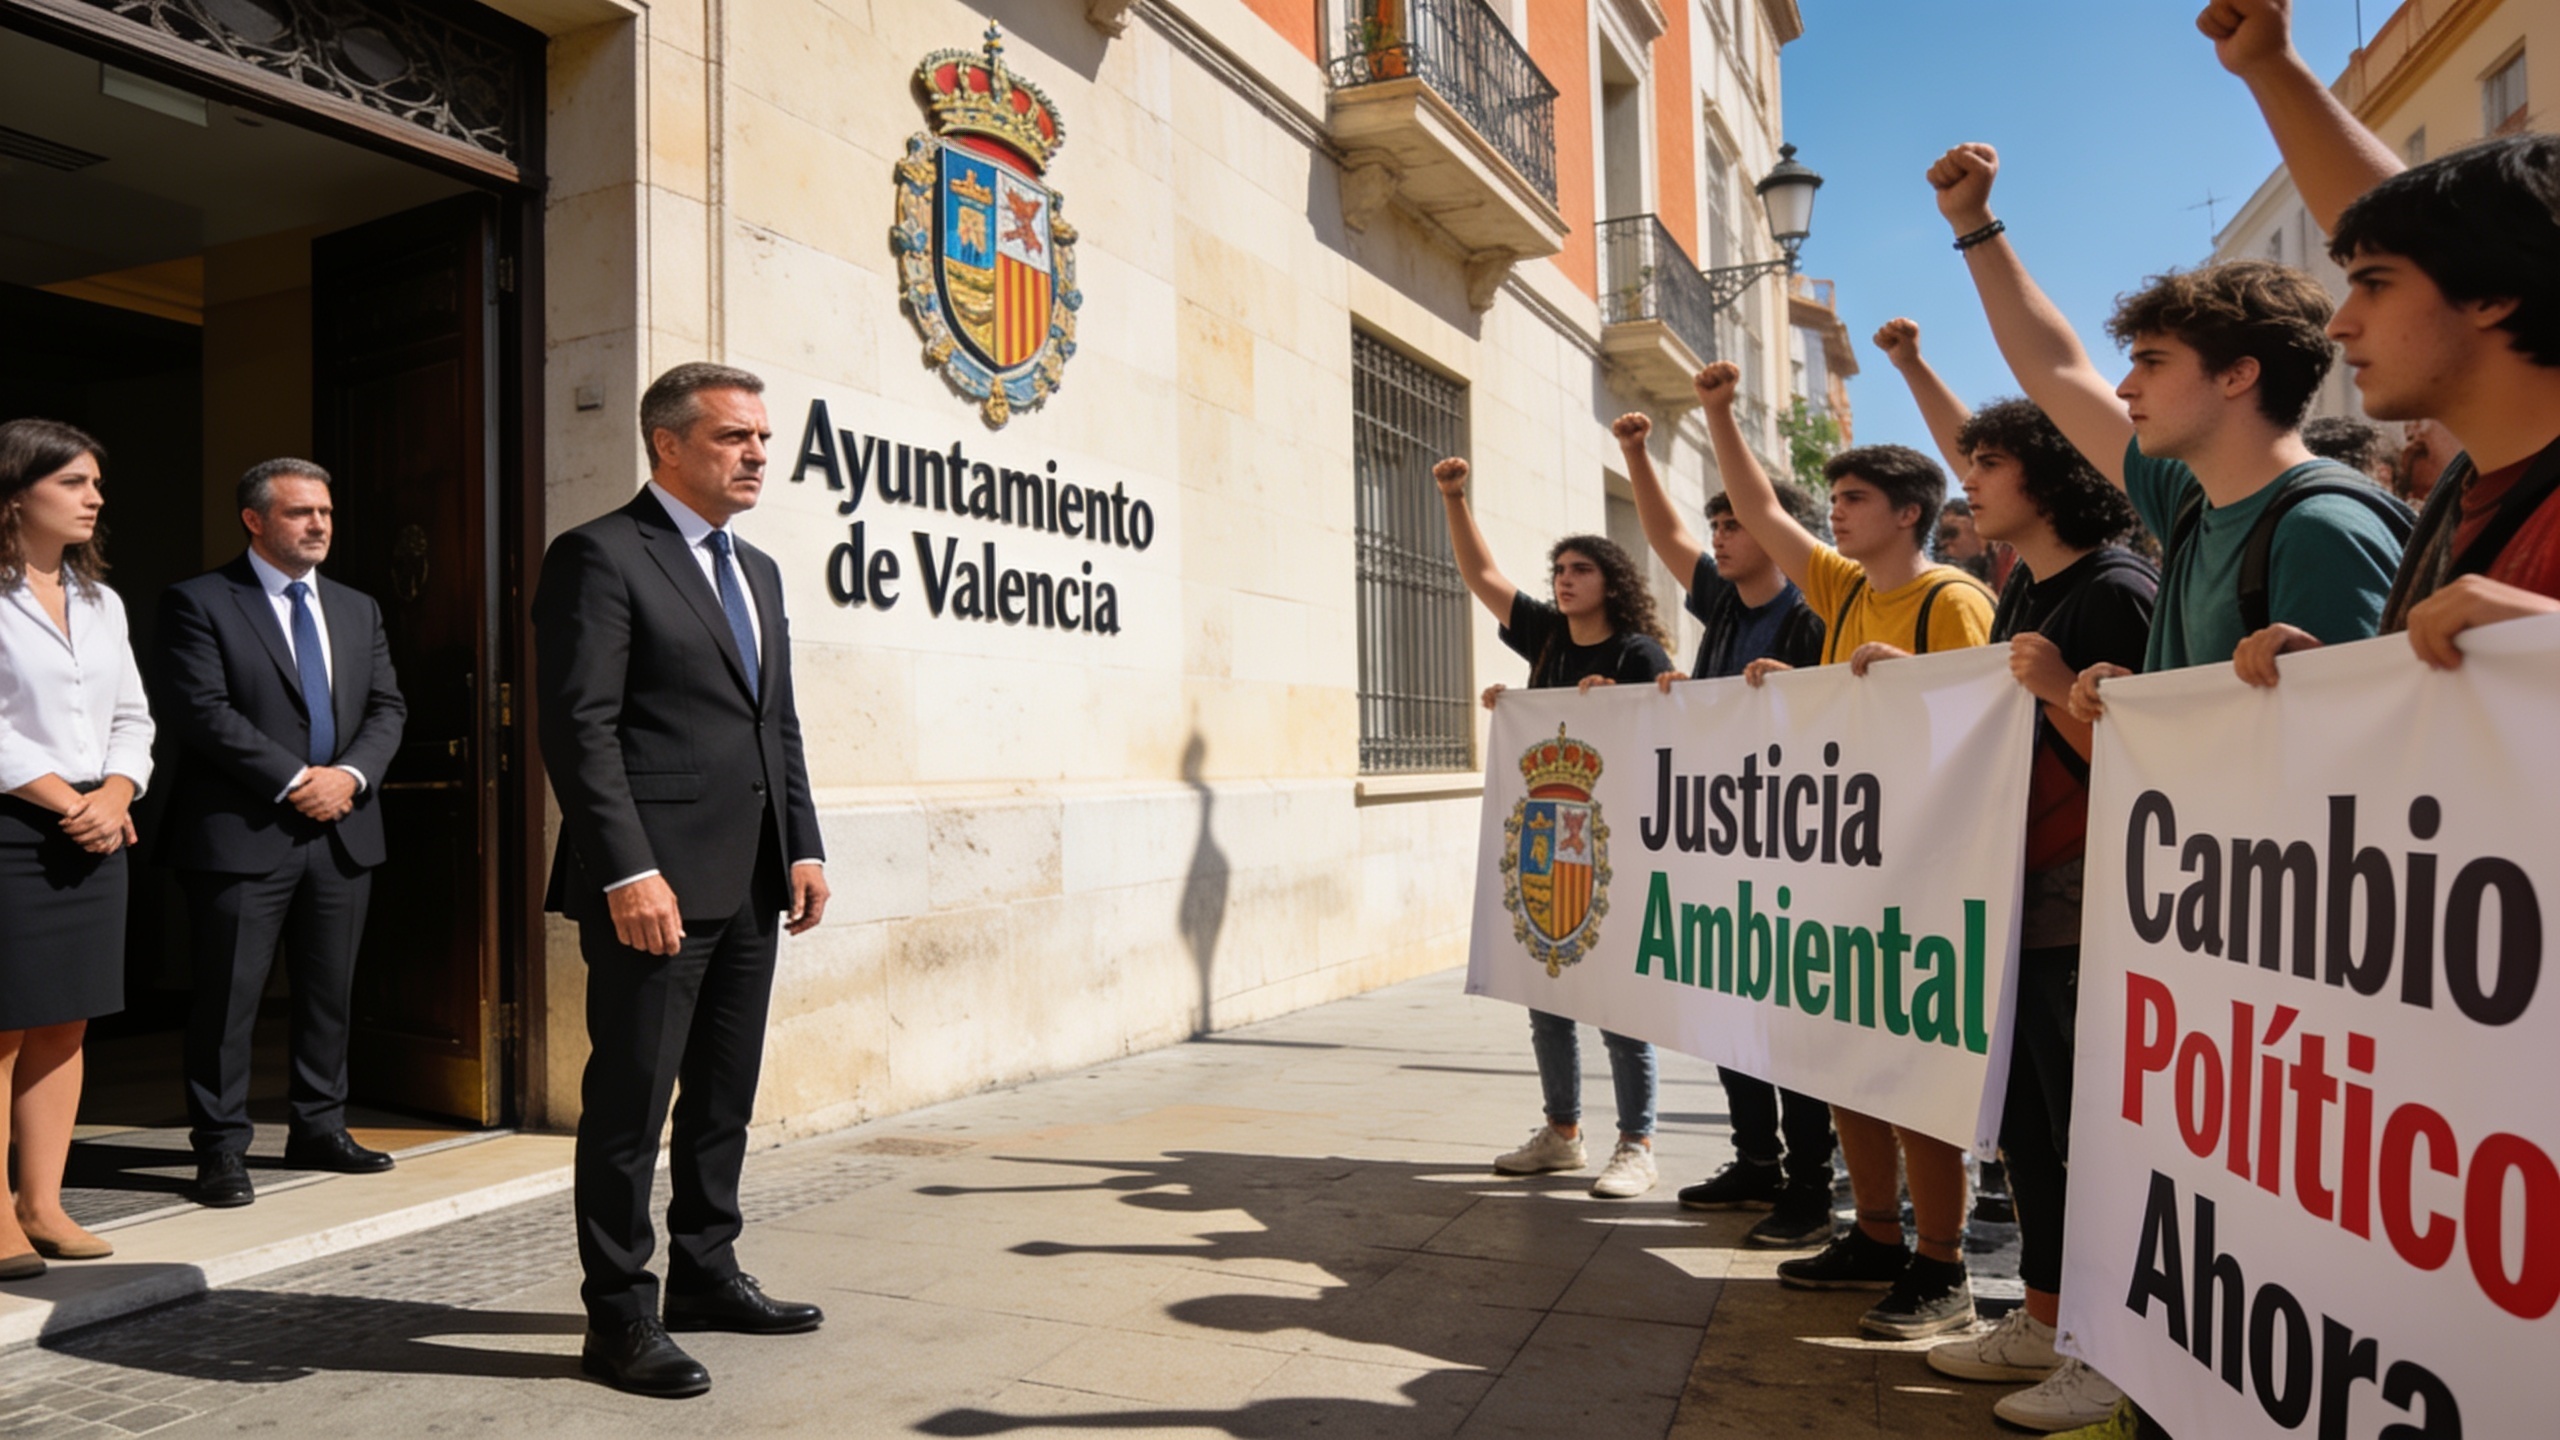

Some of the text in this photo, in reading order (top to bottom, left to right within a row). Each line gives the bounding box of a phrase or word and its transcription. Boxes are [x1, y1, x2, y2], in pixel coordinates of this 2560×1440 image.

[789, 398, 1154, 551] Ayuntamiento
[826, 520, 1120, 636] de Valencia
[1640, 741, 1882, 867] Justicia
[1635, 871, 1988, 1055] Ambiental
[2125, 789, 2542, 1026] Cambio
[2121, 970, 2560, 1320] Político
